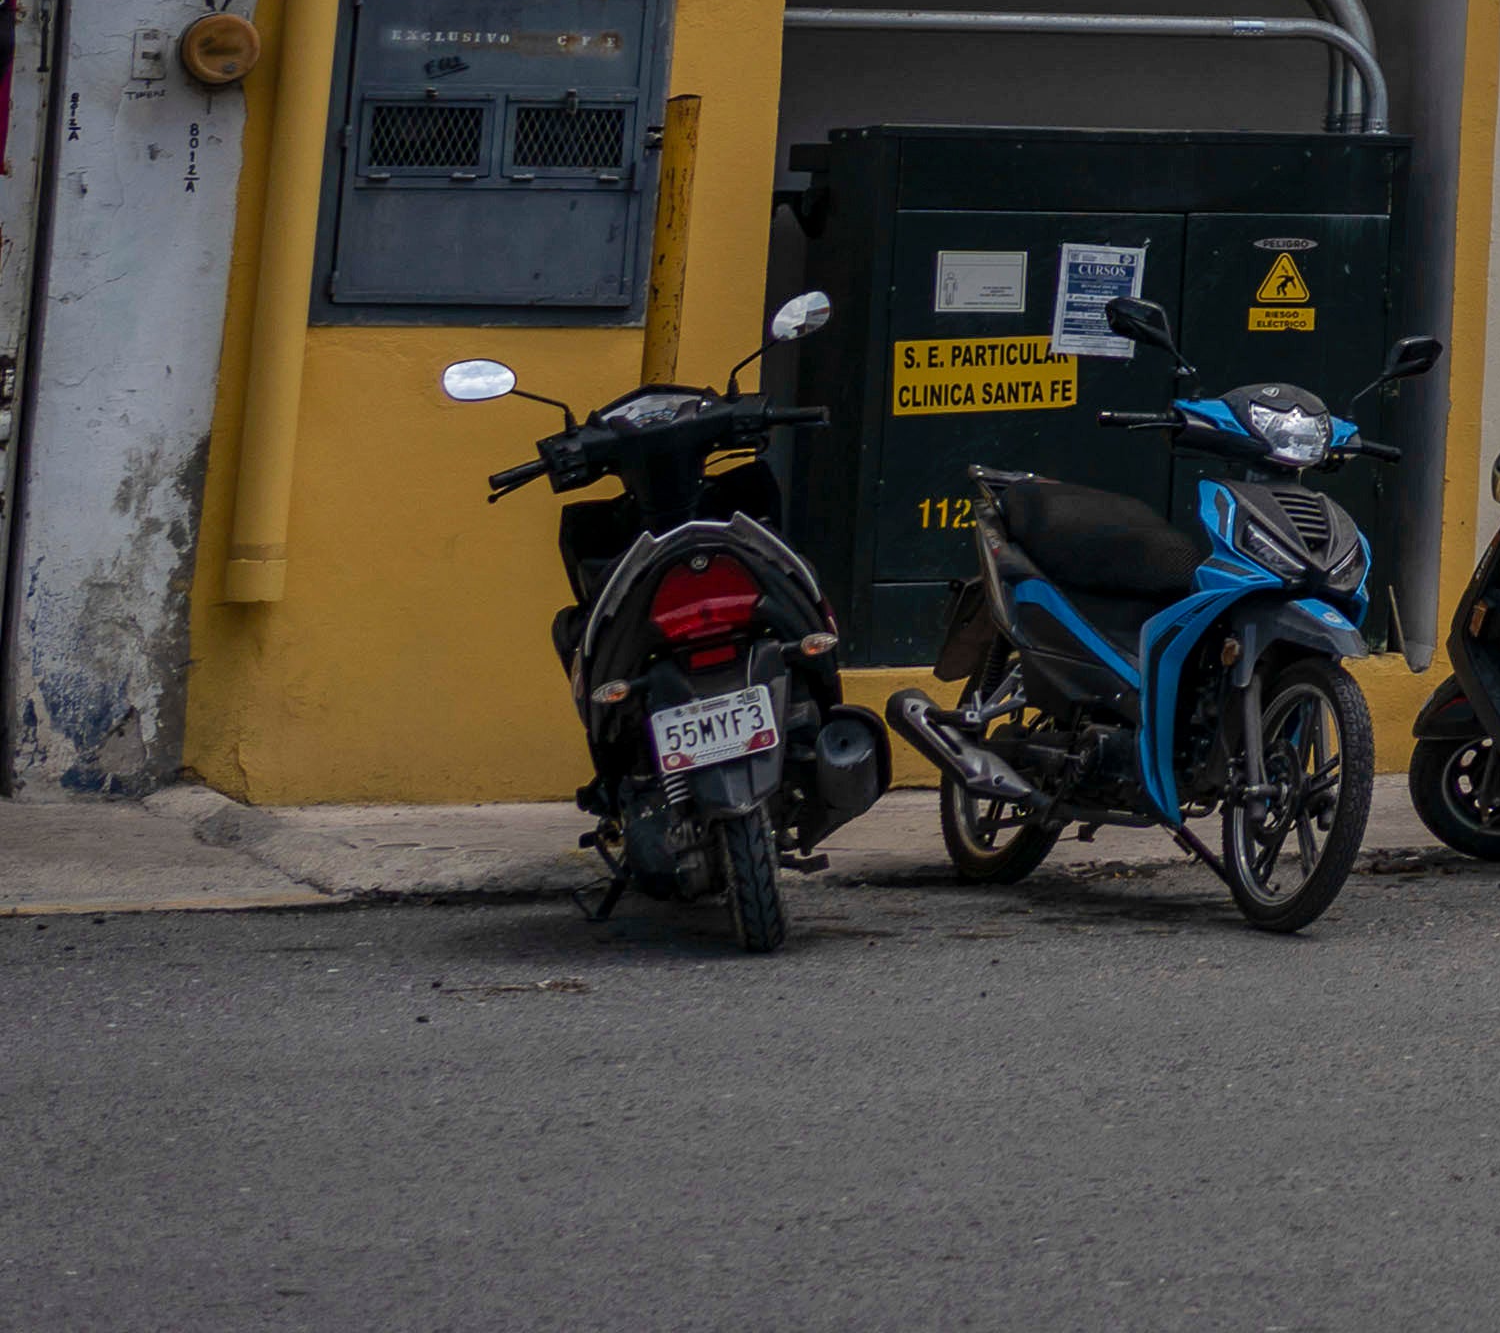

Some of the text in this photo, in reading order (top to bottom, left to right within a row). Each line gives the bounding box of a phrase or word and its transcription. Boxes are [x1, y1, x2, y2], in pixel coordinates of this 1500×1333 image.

[391, 29, 511, 46] EXCLUSIVO
[1263, 239, 1309, 249] PELIGRO
[1077, 263, 1127, 278] CURSOS
[903, 346, 921, 369] S.
[927, 345, 945, 368] E.
[898, 379, 1073, 408] CLINICA SANTA FE
[665, 703, 766, 752] 55MYF3
